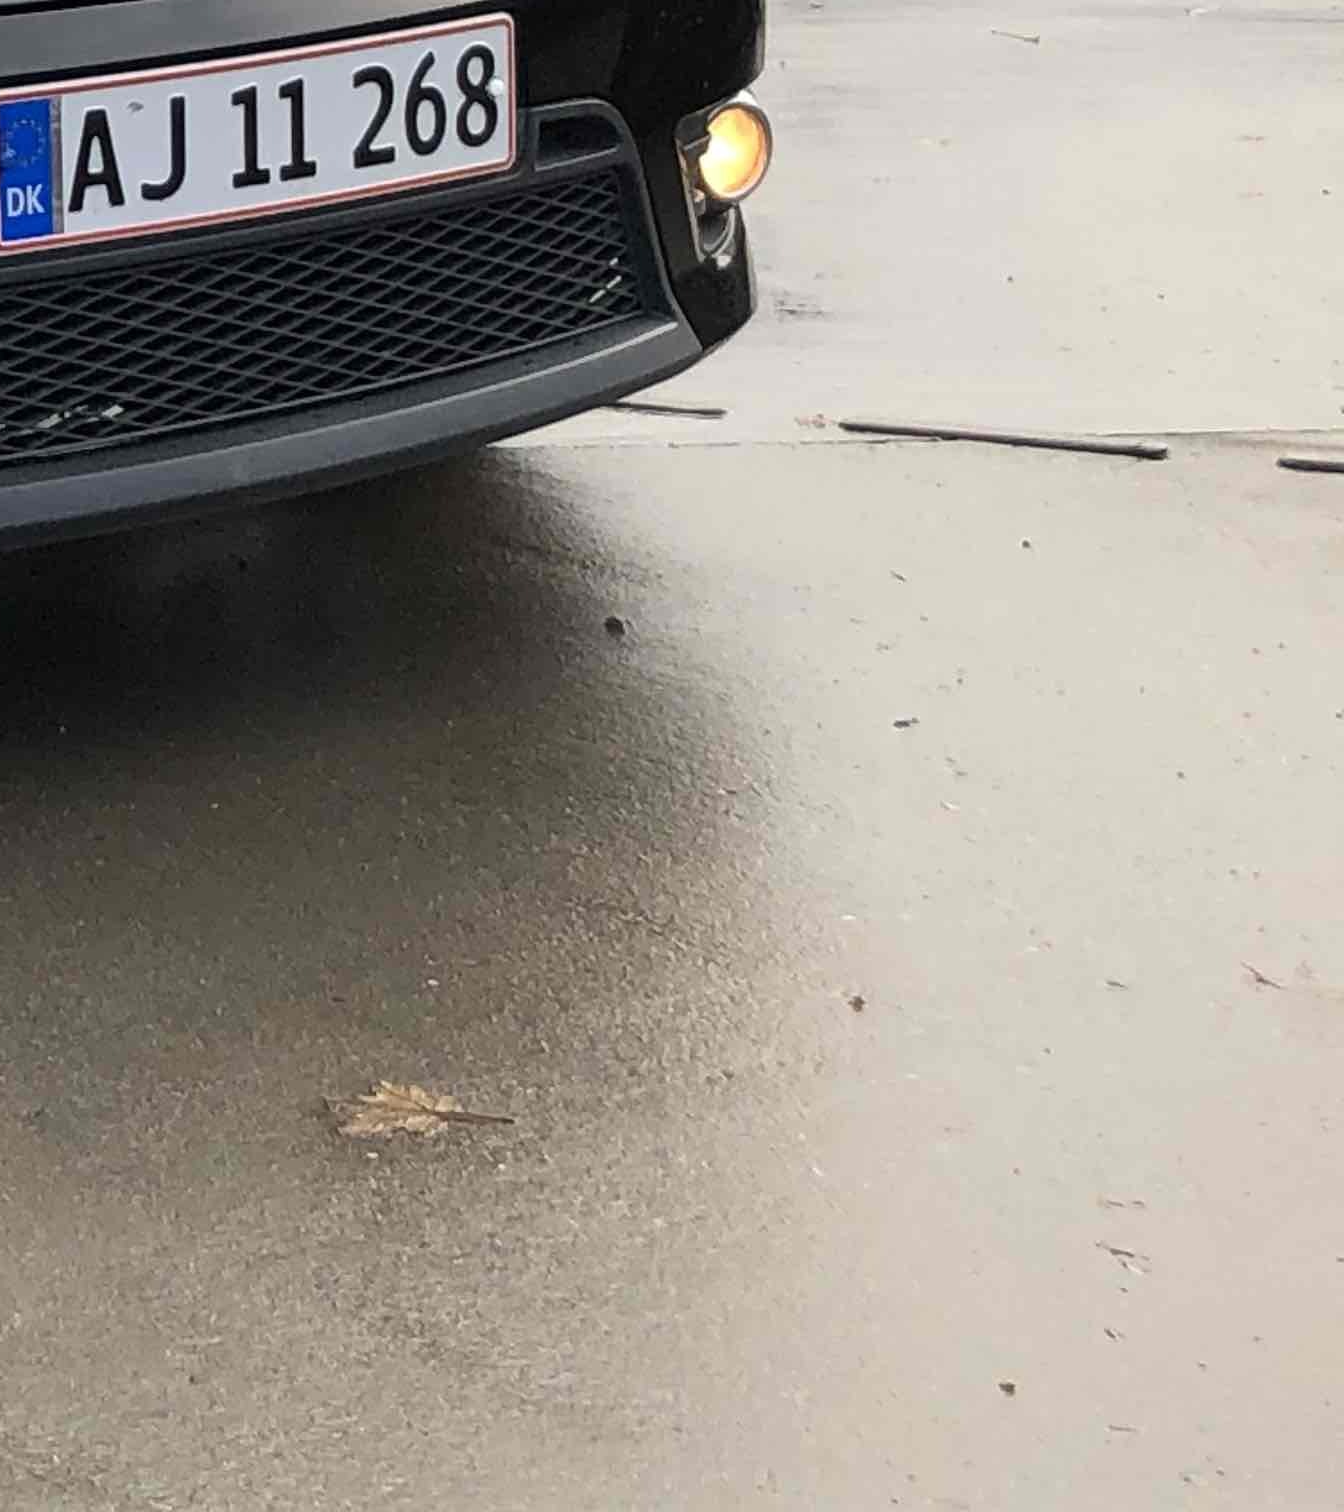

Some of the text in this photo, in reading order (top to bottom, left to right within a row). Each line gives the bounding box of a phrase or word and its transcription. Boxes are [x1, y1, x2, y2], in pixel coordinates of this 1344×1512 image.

[67, 42, 500, 214] AJ 11 268
[6, 185, 45, 219] DK
